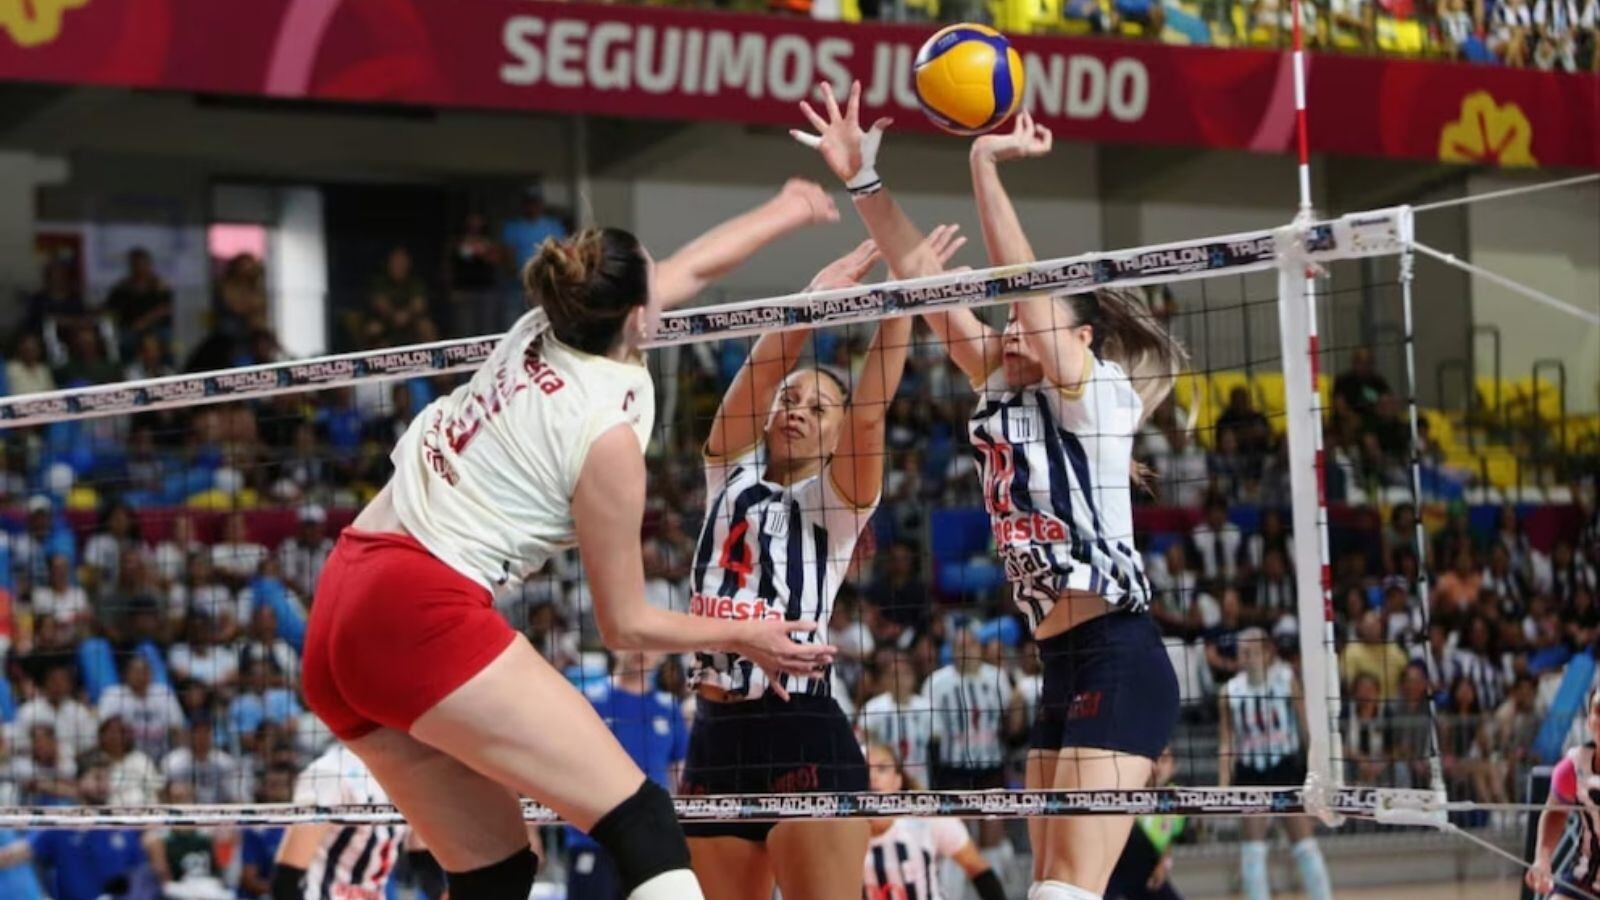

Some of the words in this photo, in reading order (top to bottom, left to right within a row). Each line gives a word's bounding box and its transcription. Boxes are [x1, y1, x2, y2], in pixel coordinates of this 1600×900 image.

[500, 16, 855, 102] SEGUIMOS
[868, 42, 1149, 121] JUNDO
[366, 351, 432, 369] TRIATHLON
[706, 307, 784, 328] TRIATHLON
[803, 293, 883, 315] TRIATHLON
[900, 280, 986, 303] TRIATHLON
[1006, 263, 1093, 288] TRIATHLON
[1112, 246, 1208, 271] TRIATHLON
[719, 519, 754, 589] 4
[690, 592, 782, 620] puesta
[674, 798, 741, 813] RIATHLON
[758, 795, 838, 811] TRIATHLON
[857, 794, 939, 809] TRIATHLON
[959, 793, 1046, 808] TRIATHLON
[1066, 791, 1157, 807] TRIATHLON
[1177, 791, 1273, 806] TRIATHLON
